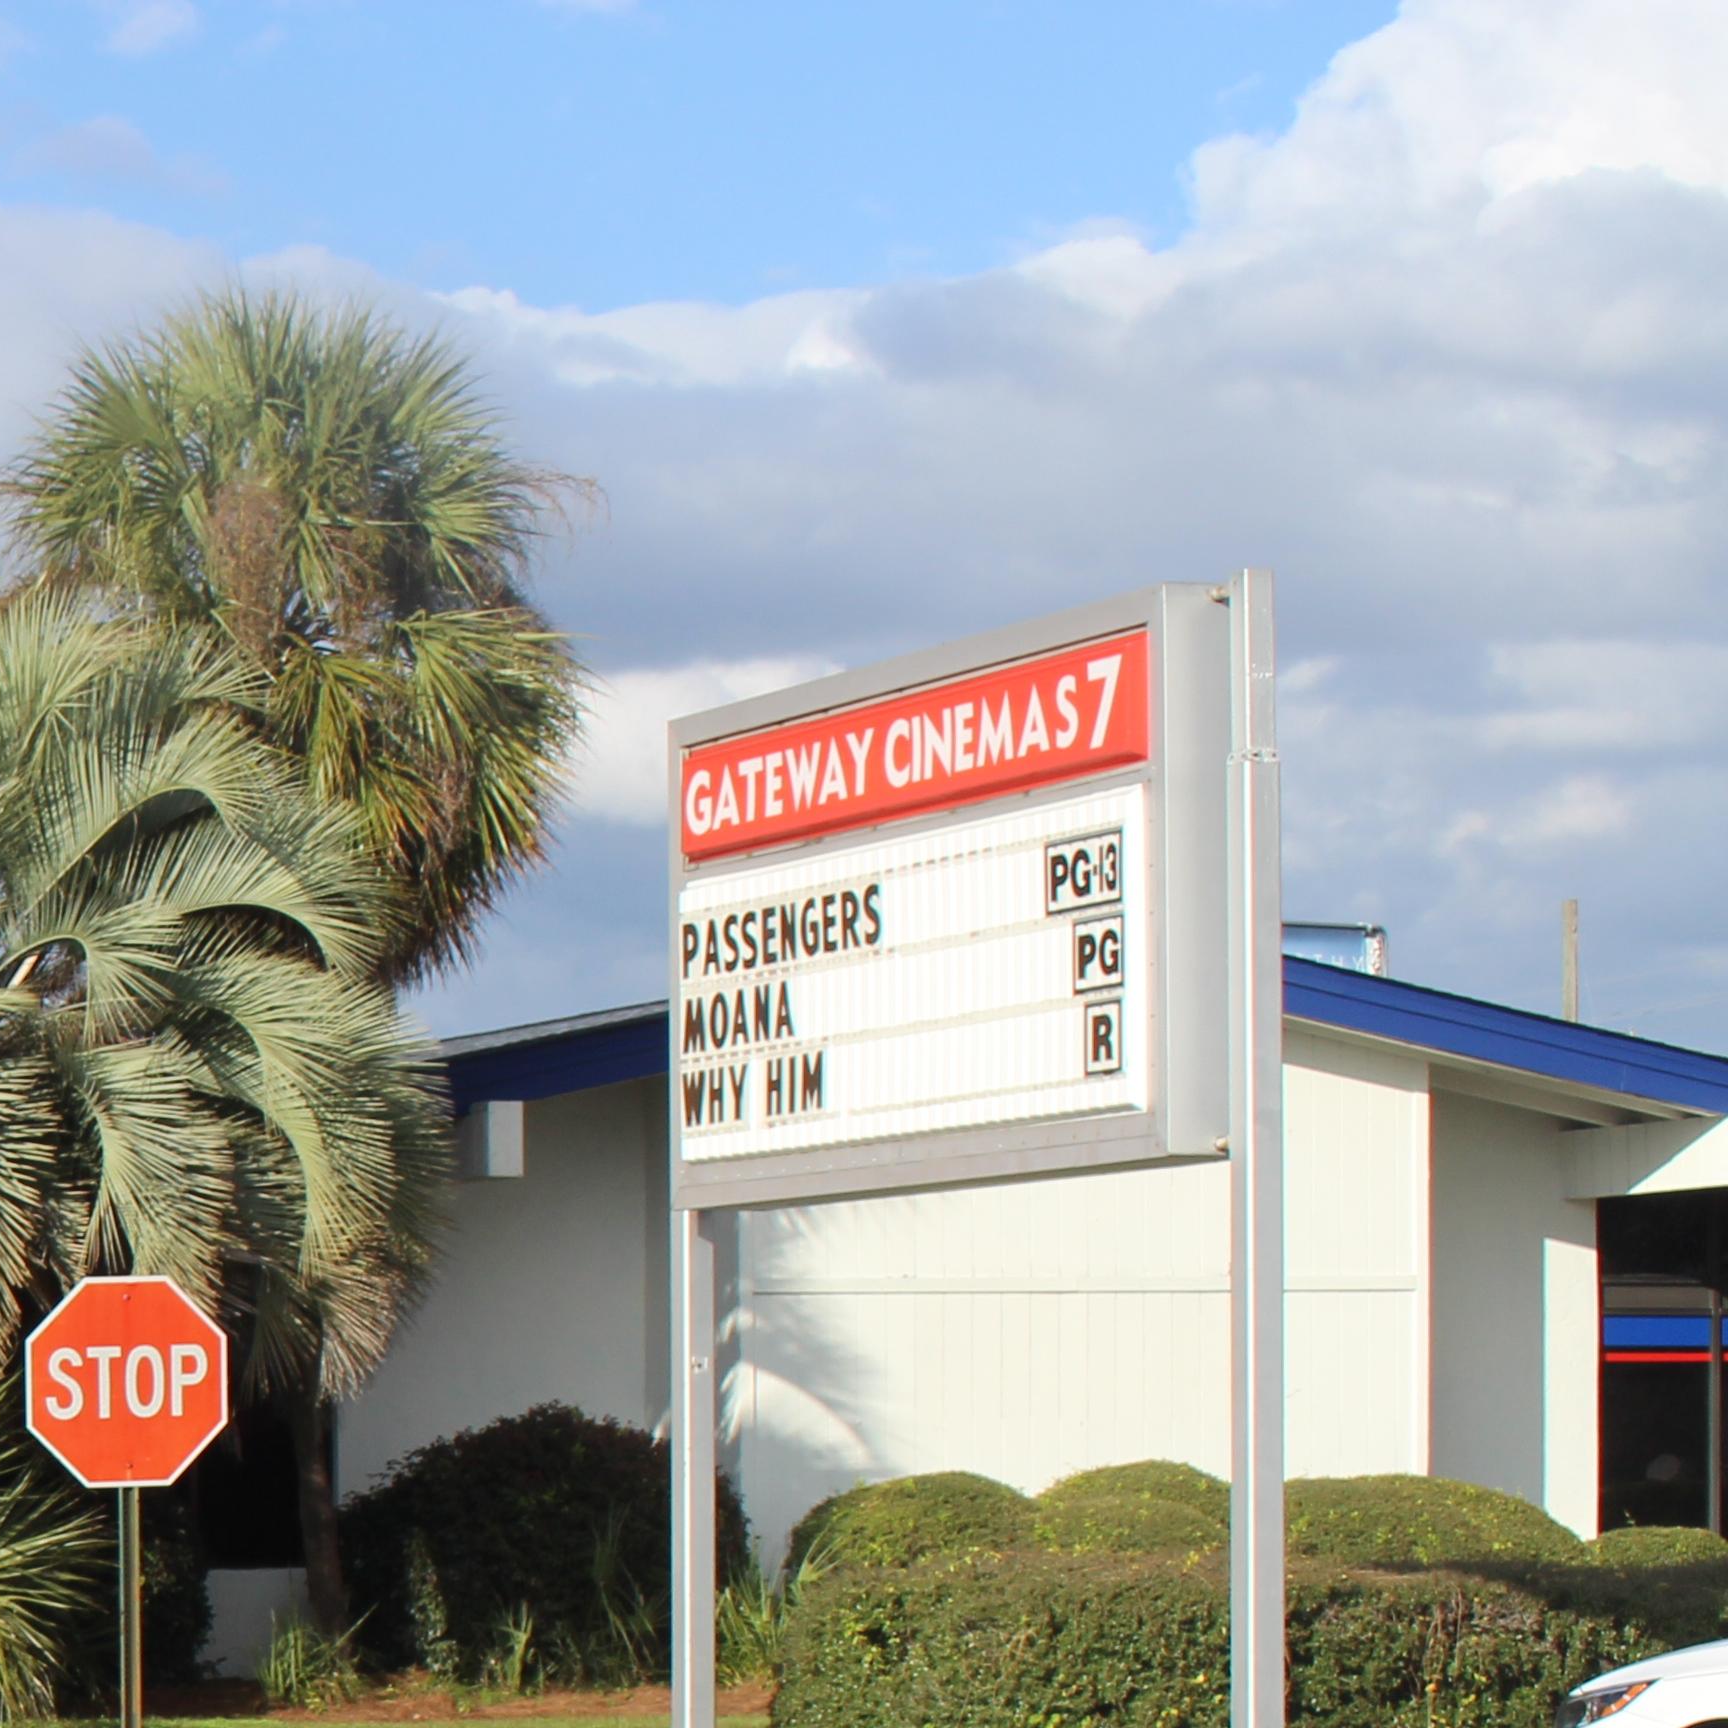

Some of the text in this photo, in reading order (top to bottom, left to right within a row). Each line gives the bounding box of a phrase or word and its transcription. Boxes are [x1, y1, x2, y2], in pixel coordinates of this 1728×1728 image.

[685, 728, 874, 836] GATEWAY
[682, 843, 1118, 980] PASSENGERS PG-13
[683, 928, 1119, 1055] MOANA PG
[681, 1013, 1114, 1128] WHY HIM R
[45, 1344, 208, 1420] STOP
